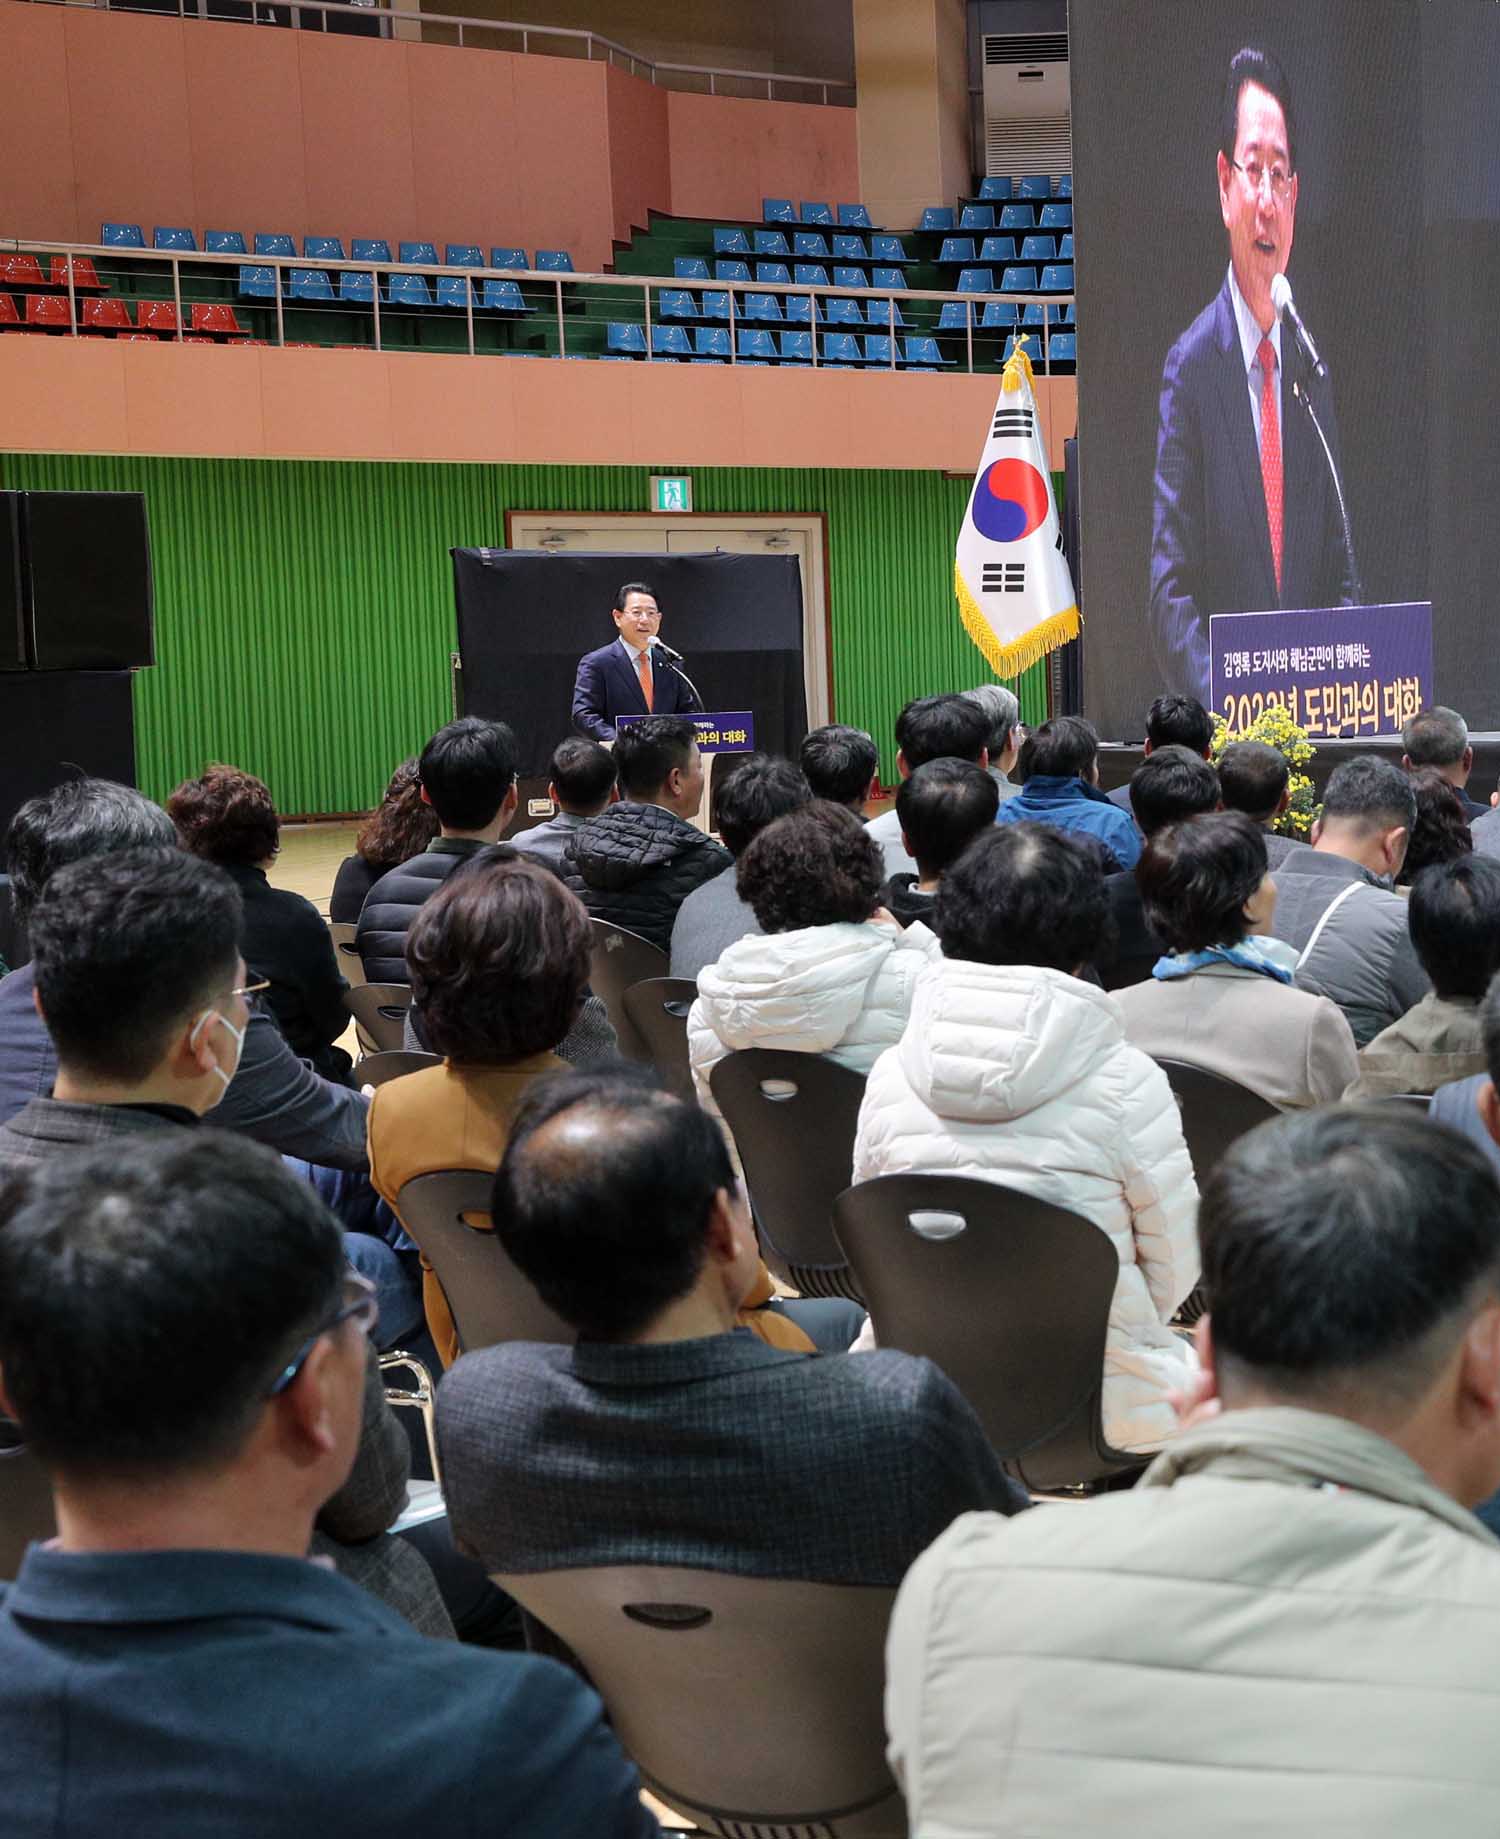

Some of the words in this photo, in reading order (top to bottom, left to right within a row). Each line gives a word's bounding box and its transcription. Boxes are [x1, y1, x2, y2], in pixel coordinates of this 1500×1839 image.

[1223, 651, 1251, 678] 김영록
[1252, 648, 1289, 675] 도지사와
[1290, 643, 1334, 673] 해남군민이
[1336, 643, 1371, 670] 함께하는
[1303, 679, 1380, 736] 도민과의
[1383, 676, 1423, 731] 대화
[722, 729, 747, 744] 대화
